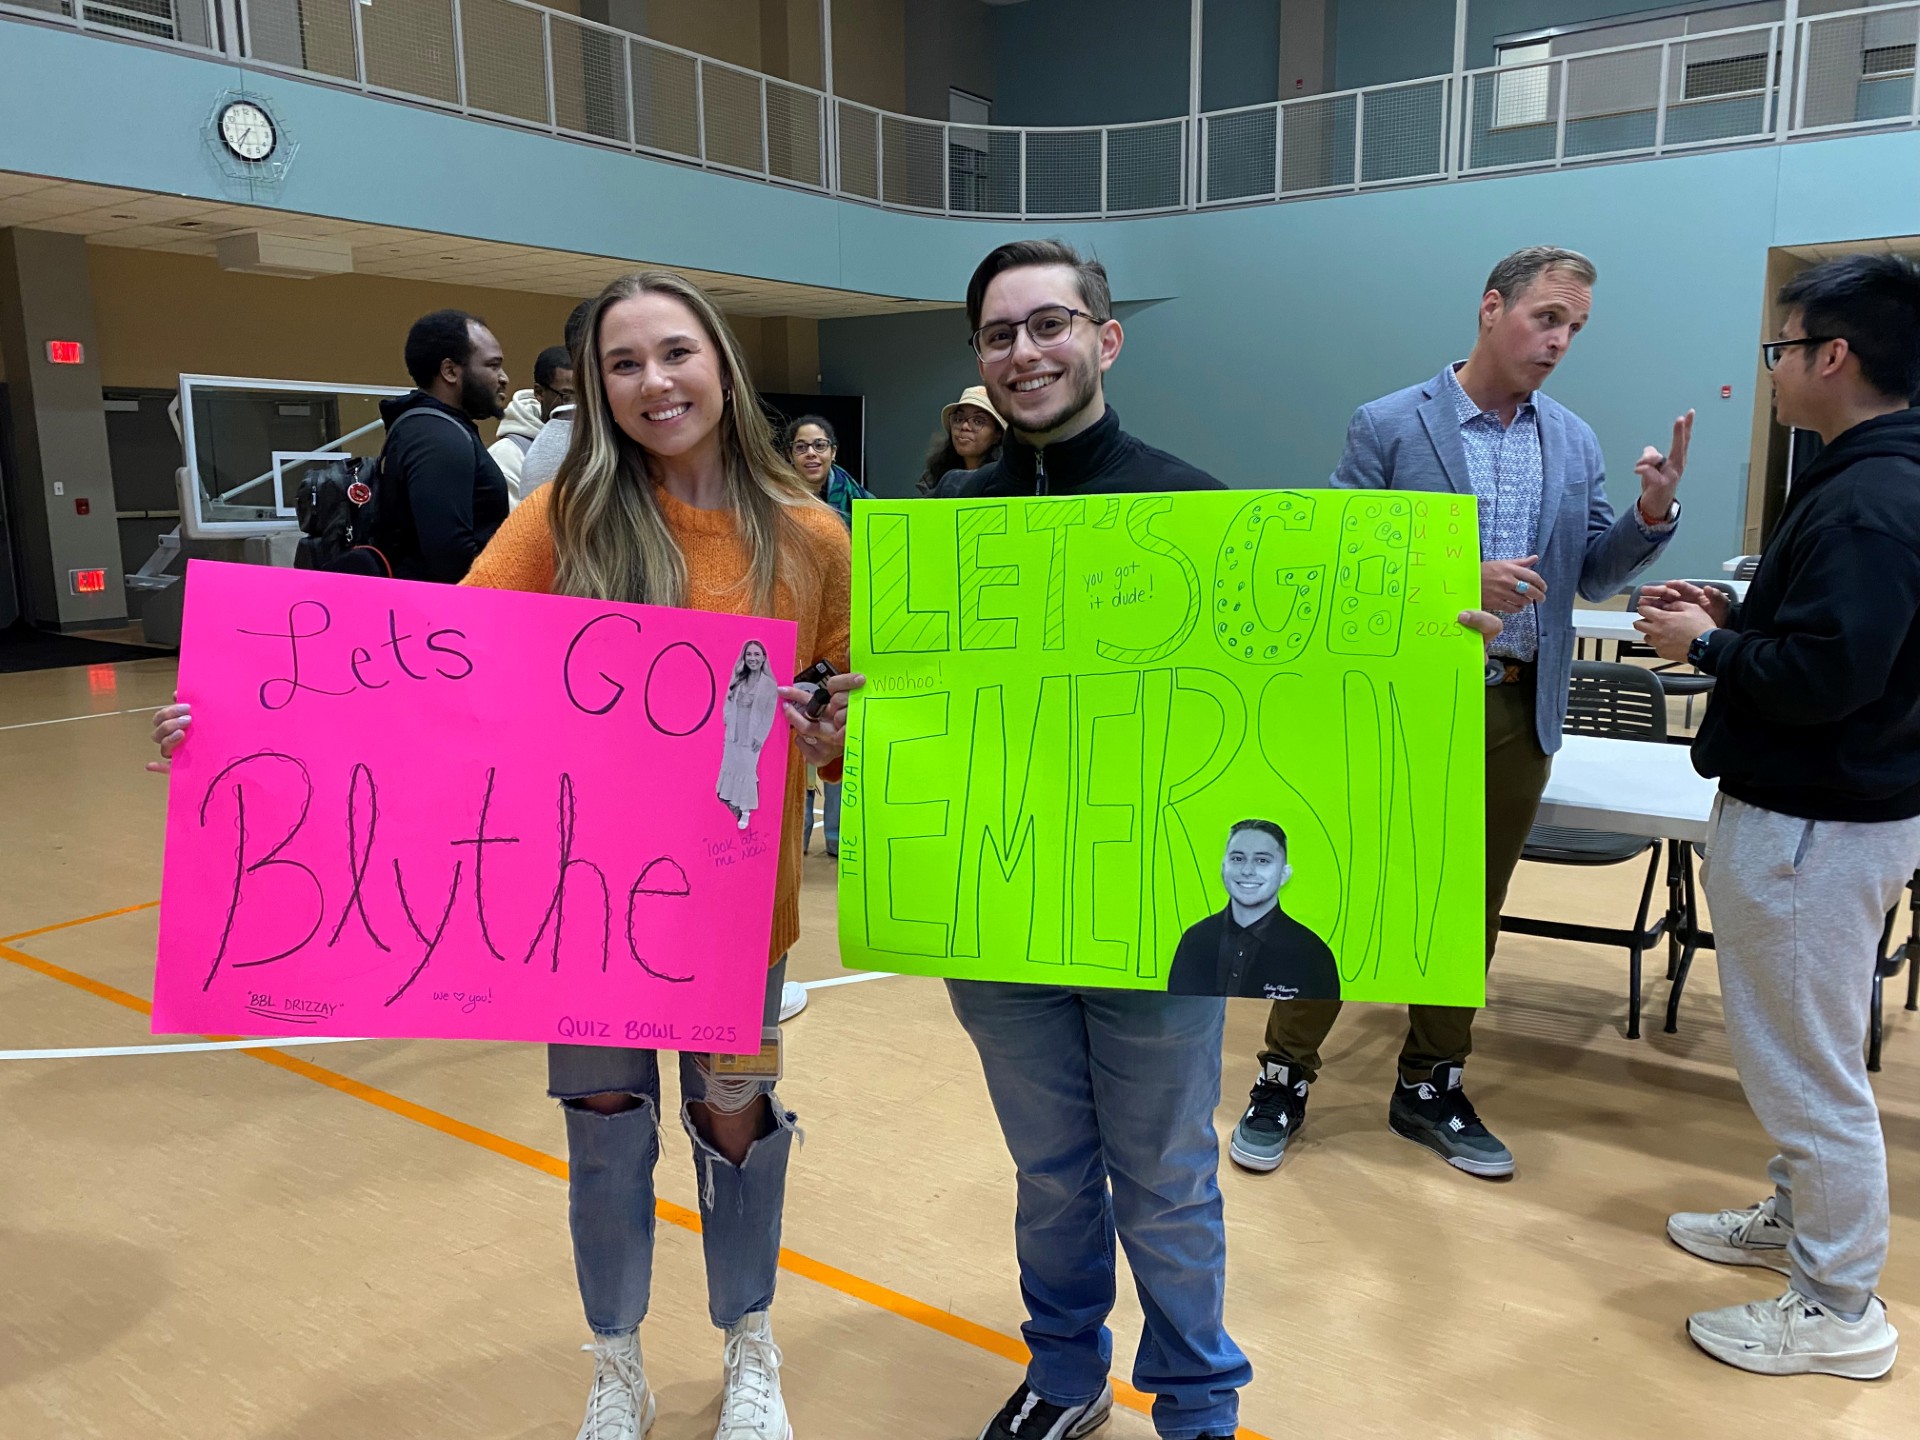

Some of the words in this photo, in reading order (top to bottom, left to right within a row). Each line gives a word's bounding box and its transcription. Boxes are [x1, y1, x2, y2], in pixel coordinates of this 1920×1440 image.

[868, 497, 1201, 664] LET'S
[1213, 491, 1412, 665] GO
[1082, 570, 1104, 593] you
[1114, 560, 1141, 590] got
[1090, 594, 1104, 610] it
[1112, 573, 1153, 608] dude!
[1416, 620, 1463, 637] 2025
[842, 735, 861, 808] GOAT!
[841, 835, 858, 879] THE
[199, 751, 695, 1007] Blythe
[433, 991, 449, 1001] we
[461, 987, 493, 1014] you!
[557, 1016, 611, 1038] QUIZ
[624, 1020, 682, 1041] BOWL
[690, 1025, 737, 1043] 2025
